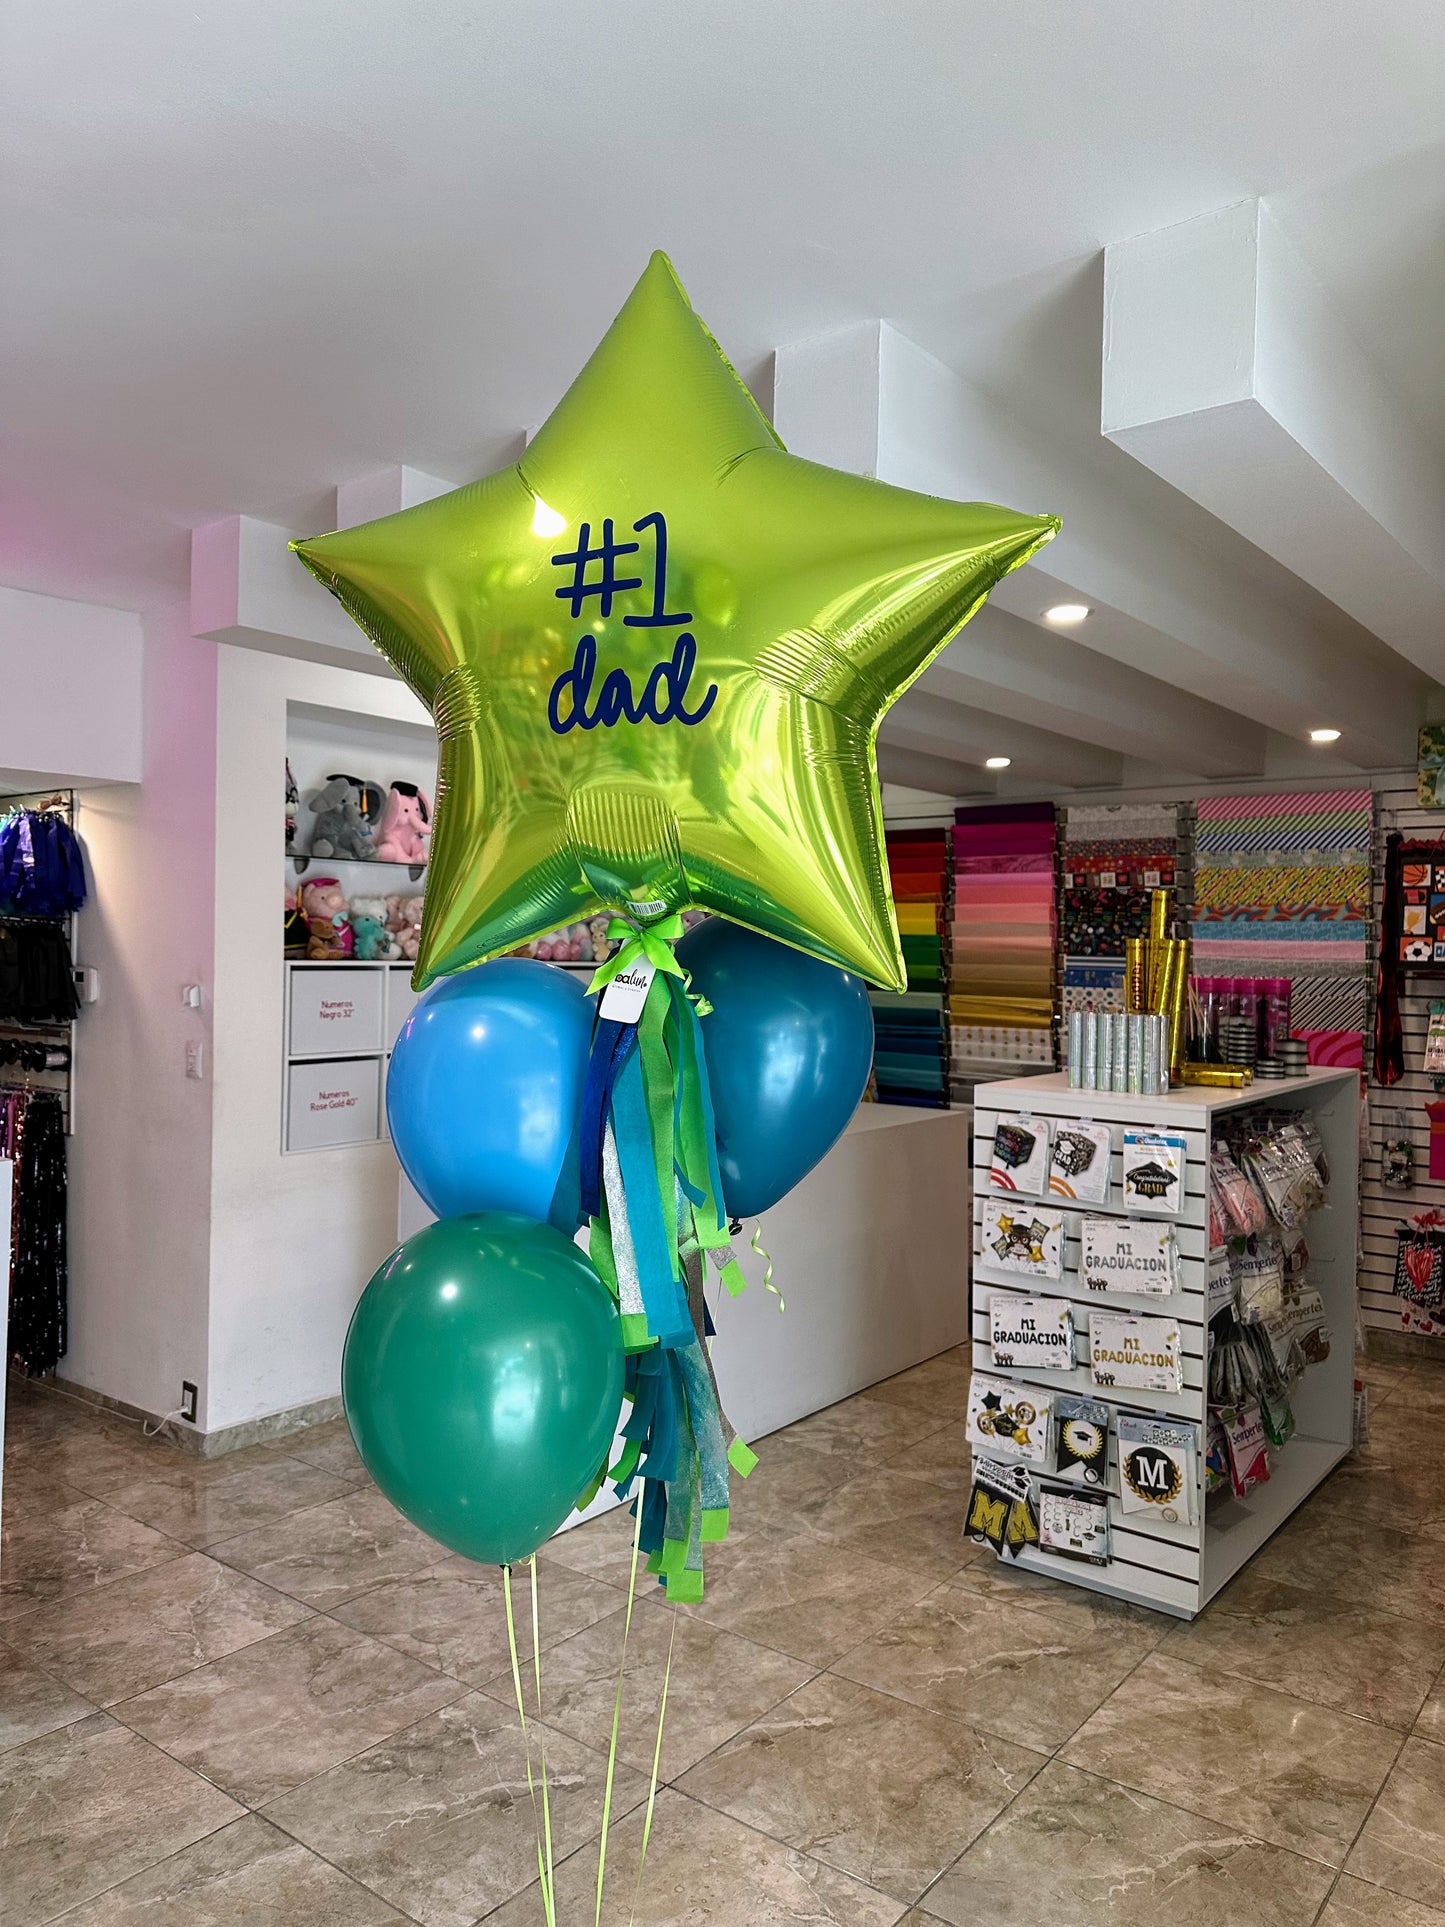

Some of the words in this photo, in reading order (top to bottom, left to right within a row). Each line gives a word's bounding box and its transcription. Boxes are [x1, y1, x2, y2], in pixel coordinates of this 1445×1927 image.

[551, 511, 693, 627] #1
[548, 632, 718, 734] dad
[319, 1010, 342, 1021] Negro
[310, 1102, 328, 1111] Rose
[329, 1099, 345, 1109] Gold
[1055, 1149, 1072, 1165] GRAD
[1138, 1181, 1164, 1194] GRAD
[1116, 1242, 1133, 1256] MI
[1085, 1255, 1167, 1272] GRADUACION
[1020, 1318, 1036, 1331] MI
[993, 1331, 1067, 1346] GRADUACION
[1123, 1337, 1140, 1351] MI
[1093, 1349, 1174, 1368] GRADUACION
[1136, 1455, 1169, 1490] M
[969, 1489, 1008, 1540] M
